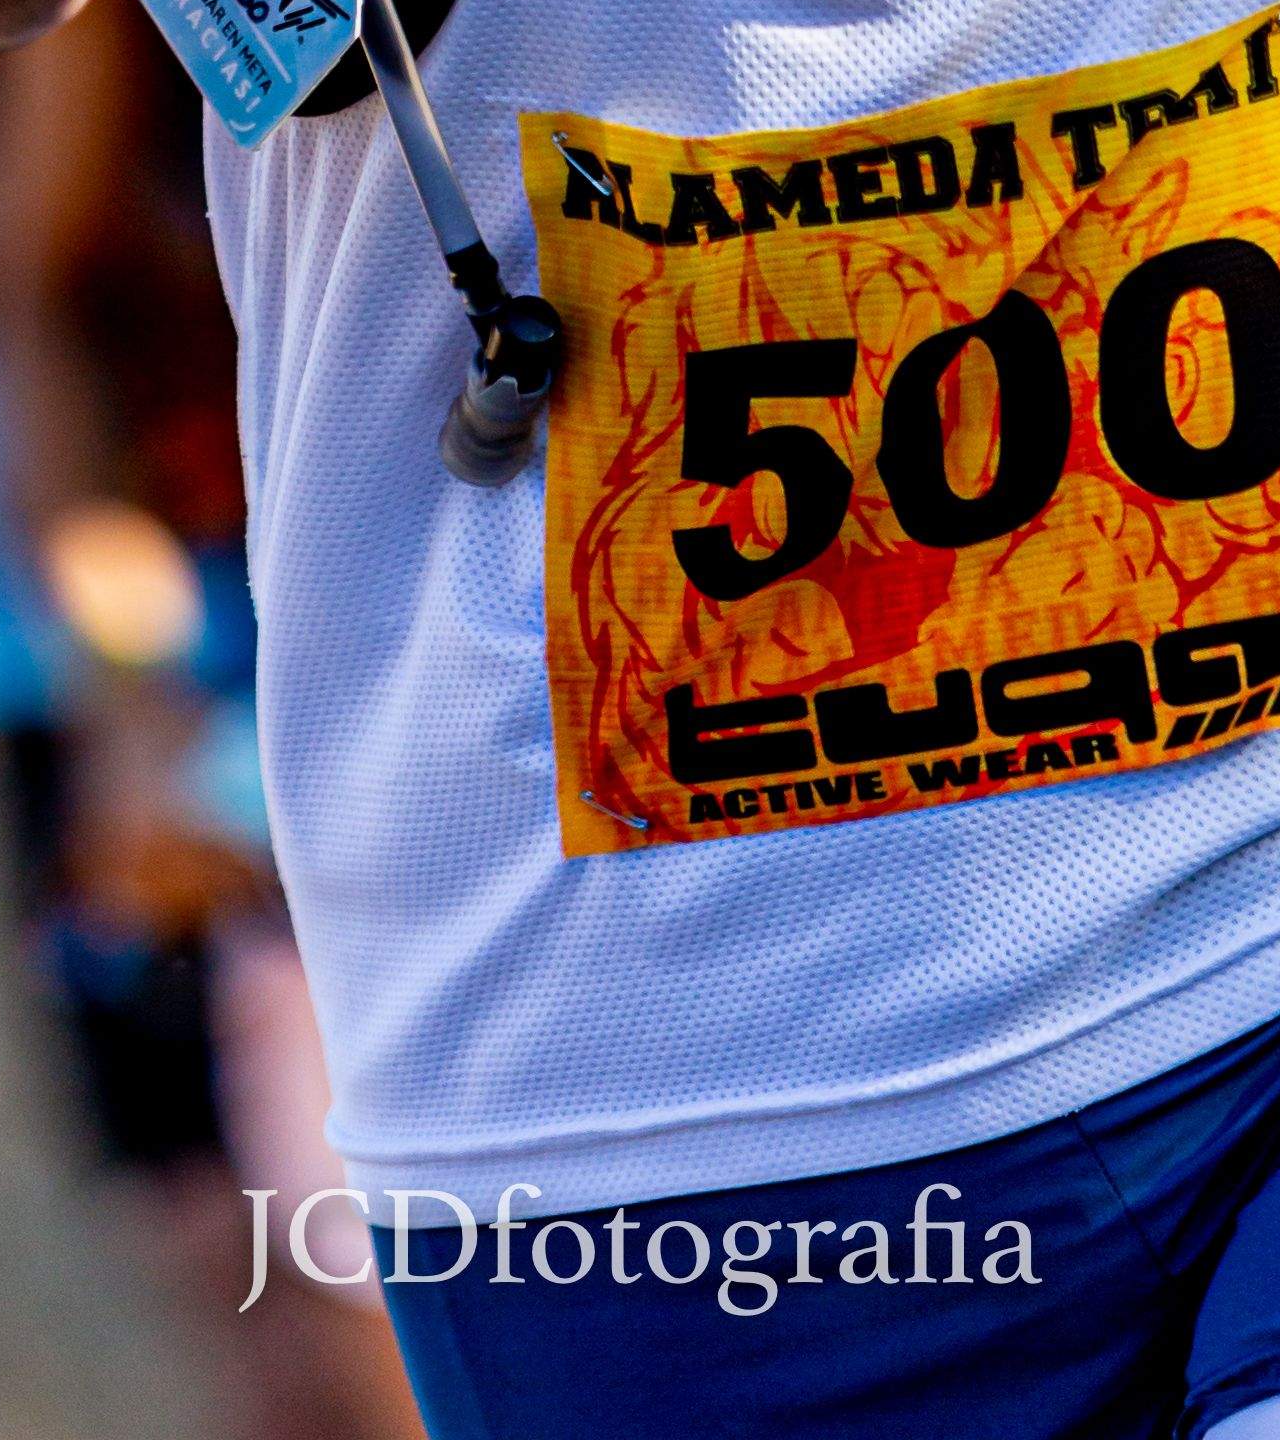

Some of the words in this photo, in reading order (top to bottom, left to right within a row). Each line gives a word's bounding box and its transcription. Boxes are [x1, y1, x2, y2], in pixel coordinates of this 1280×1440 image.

[222, 20, 243, 50] EN
[239, 46, 273, 95] META
[562, 121, 1025, 247] ALAMEDA
[689, 769, 887, 825] ACTIVE
[907, 733, 1120, 794] WEAR
